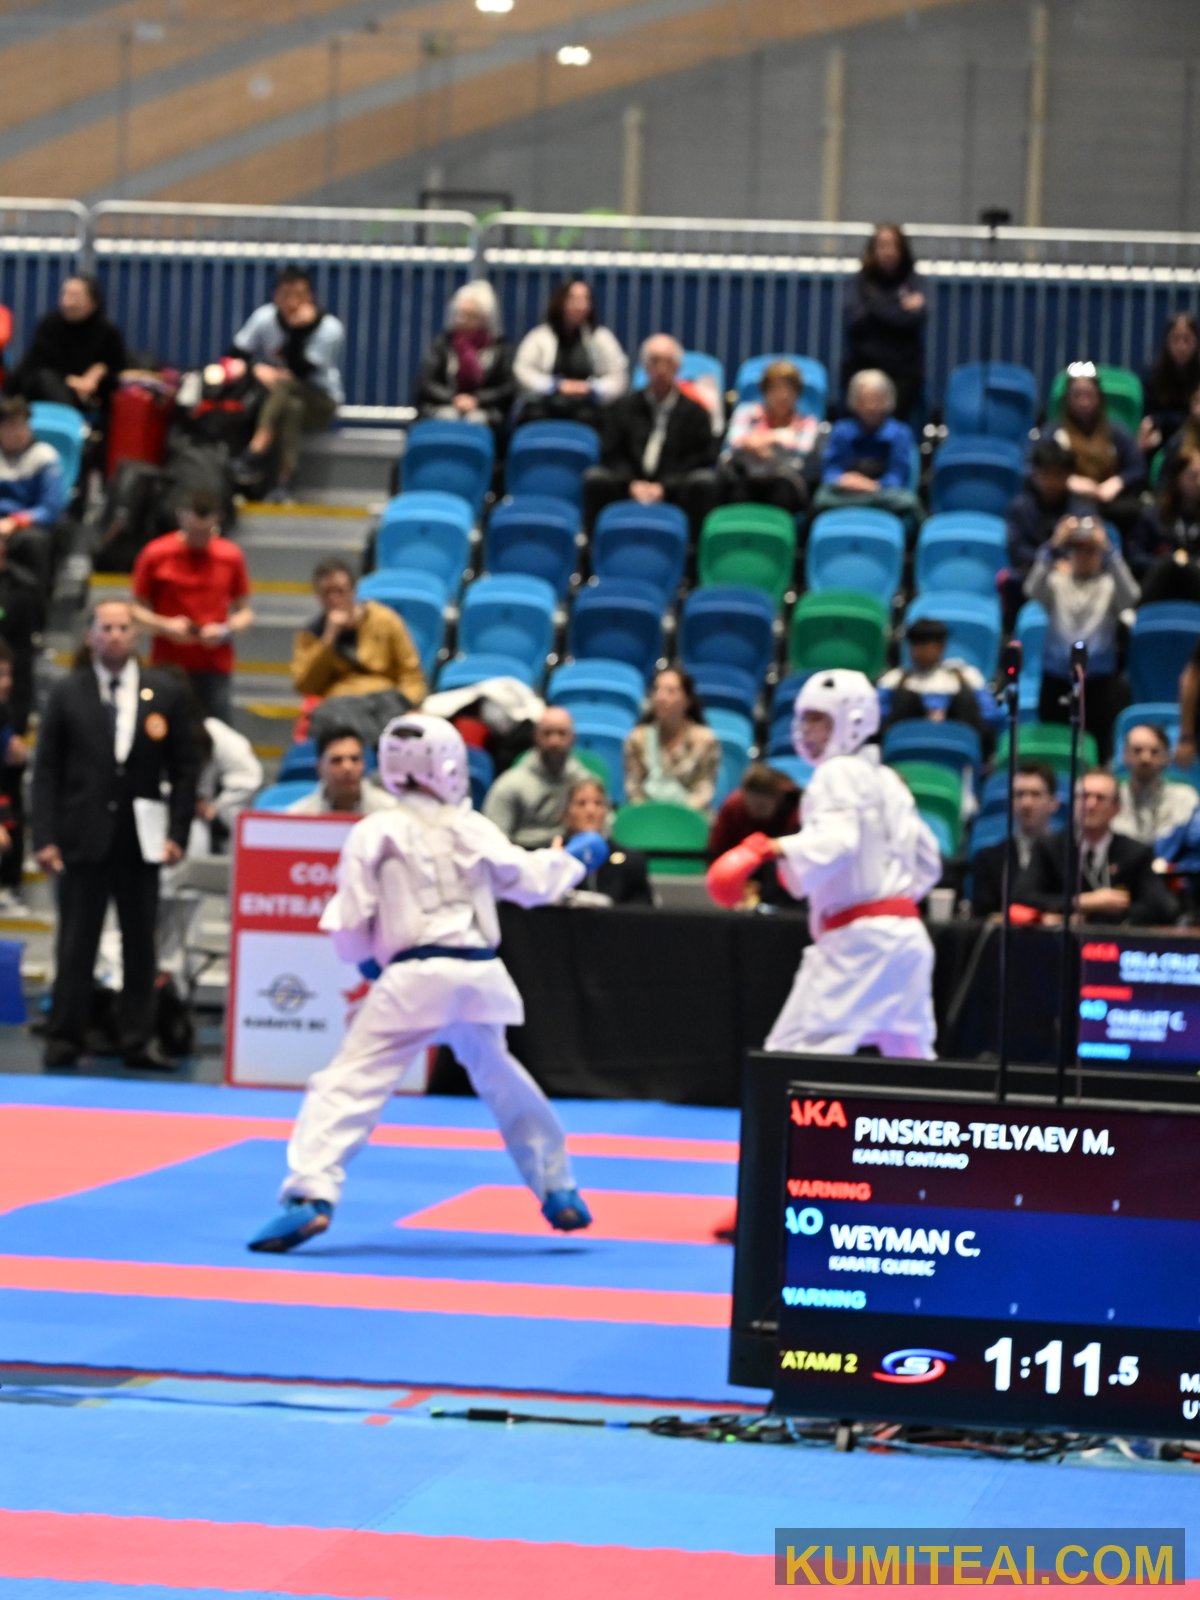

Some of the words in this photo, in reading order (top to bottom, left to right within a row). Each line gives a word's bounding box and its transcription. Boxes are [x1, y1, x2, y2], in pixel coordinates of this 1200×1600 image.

[239, 891, 332, 917] ENTRA
[854, 1116, 1078, 1154] PINSKER-TELYAEV
[1082, 1128, 1115, 1156] M.
[852, 1148, 904, 1167] KARATE
[905, 1151, 969, 1170] ONTARIO
[830, 1224, 950, 1256] WEYMAN
[954, 1230, 981, 1257] C.
[828, 1255, 880, 1273] KARATE
[881, 1258, 936, 1276] QUEBEC
[779, 1351, 841, 1372] ATAMI
[844, 1353, 858, 1373] 2
[1182, 1399, 1200, 1420] U
